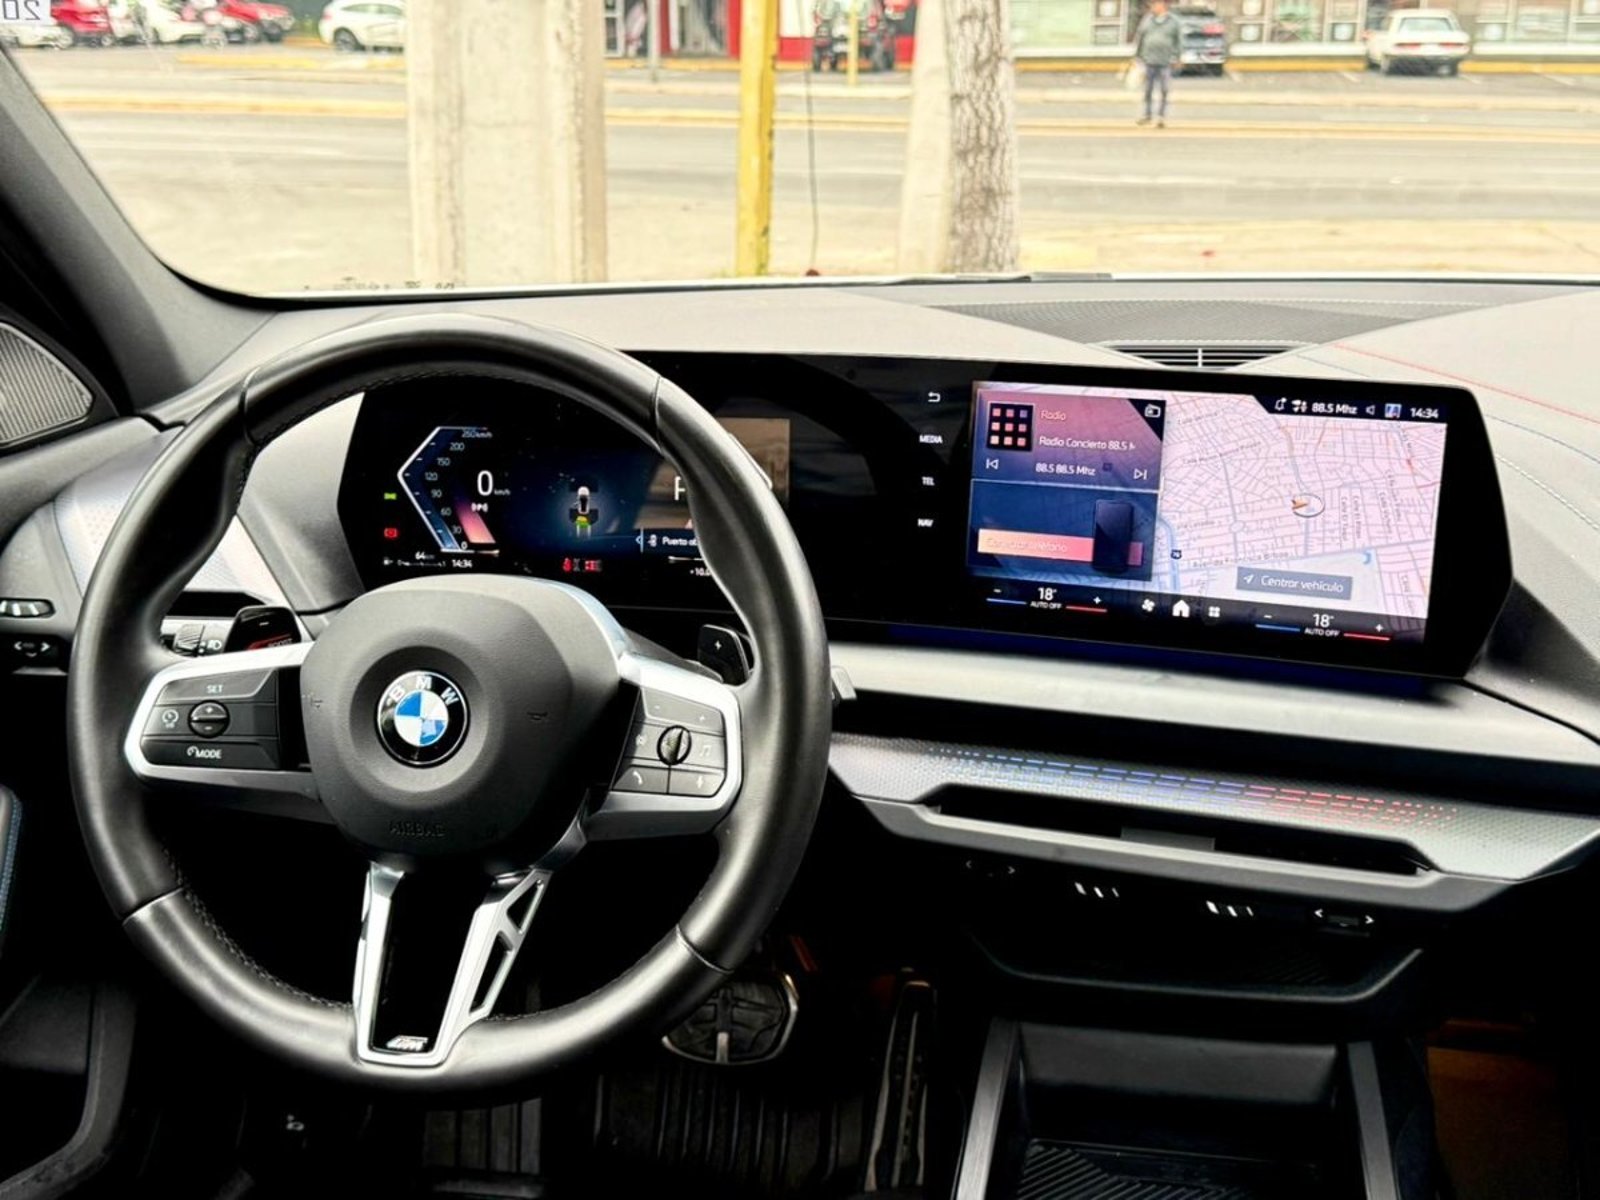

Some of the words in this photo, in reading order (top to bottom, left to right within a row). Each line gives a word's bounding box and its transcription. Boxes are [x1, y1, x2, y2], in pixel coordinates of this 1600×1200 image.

[1312, 402, 1334, 413] 88.5
[1336, 403, 1358, 415] Mhz
[1410, 408, 1439, 419] 14:34
[1040, 410, 1066, 421] Radio
[919, 434, 943, 444] MEDIA
[1038, 436, 1065, 448] Radio
[1066, 439, 1106, 450] Concierto
[1108, 440, 1127, 451] 88.5
[449, 442, 465, 451] 200
[477, 470, 494, 497] 0
[921, 476, 936, 486] TEL
[431, 489, 442, 498] 90
[440, 507, 452, 516] 60
[917, 518, 934, 528] NAV
[452, 526, 462, 535] 30
[461, 541, 468, 551] 0
[451, 559, 472, 568] 14:34
[1260, 574, 1299, 589] Centrar
[1030, 600, 1046, 609] AUTO
[1304, 628, 1323, 636] AUTO
[206, 684, 224, 694] SET
[386, 674, 460, 708] BMW
[195, 749, 222, 760] MODE
